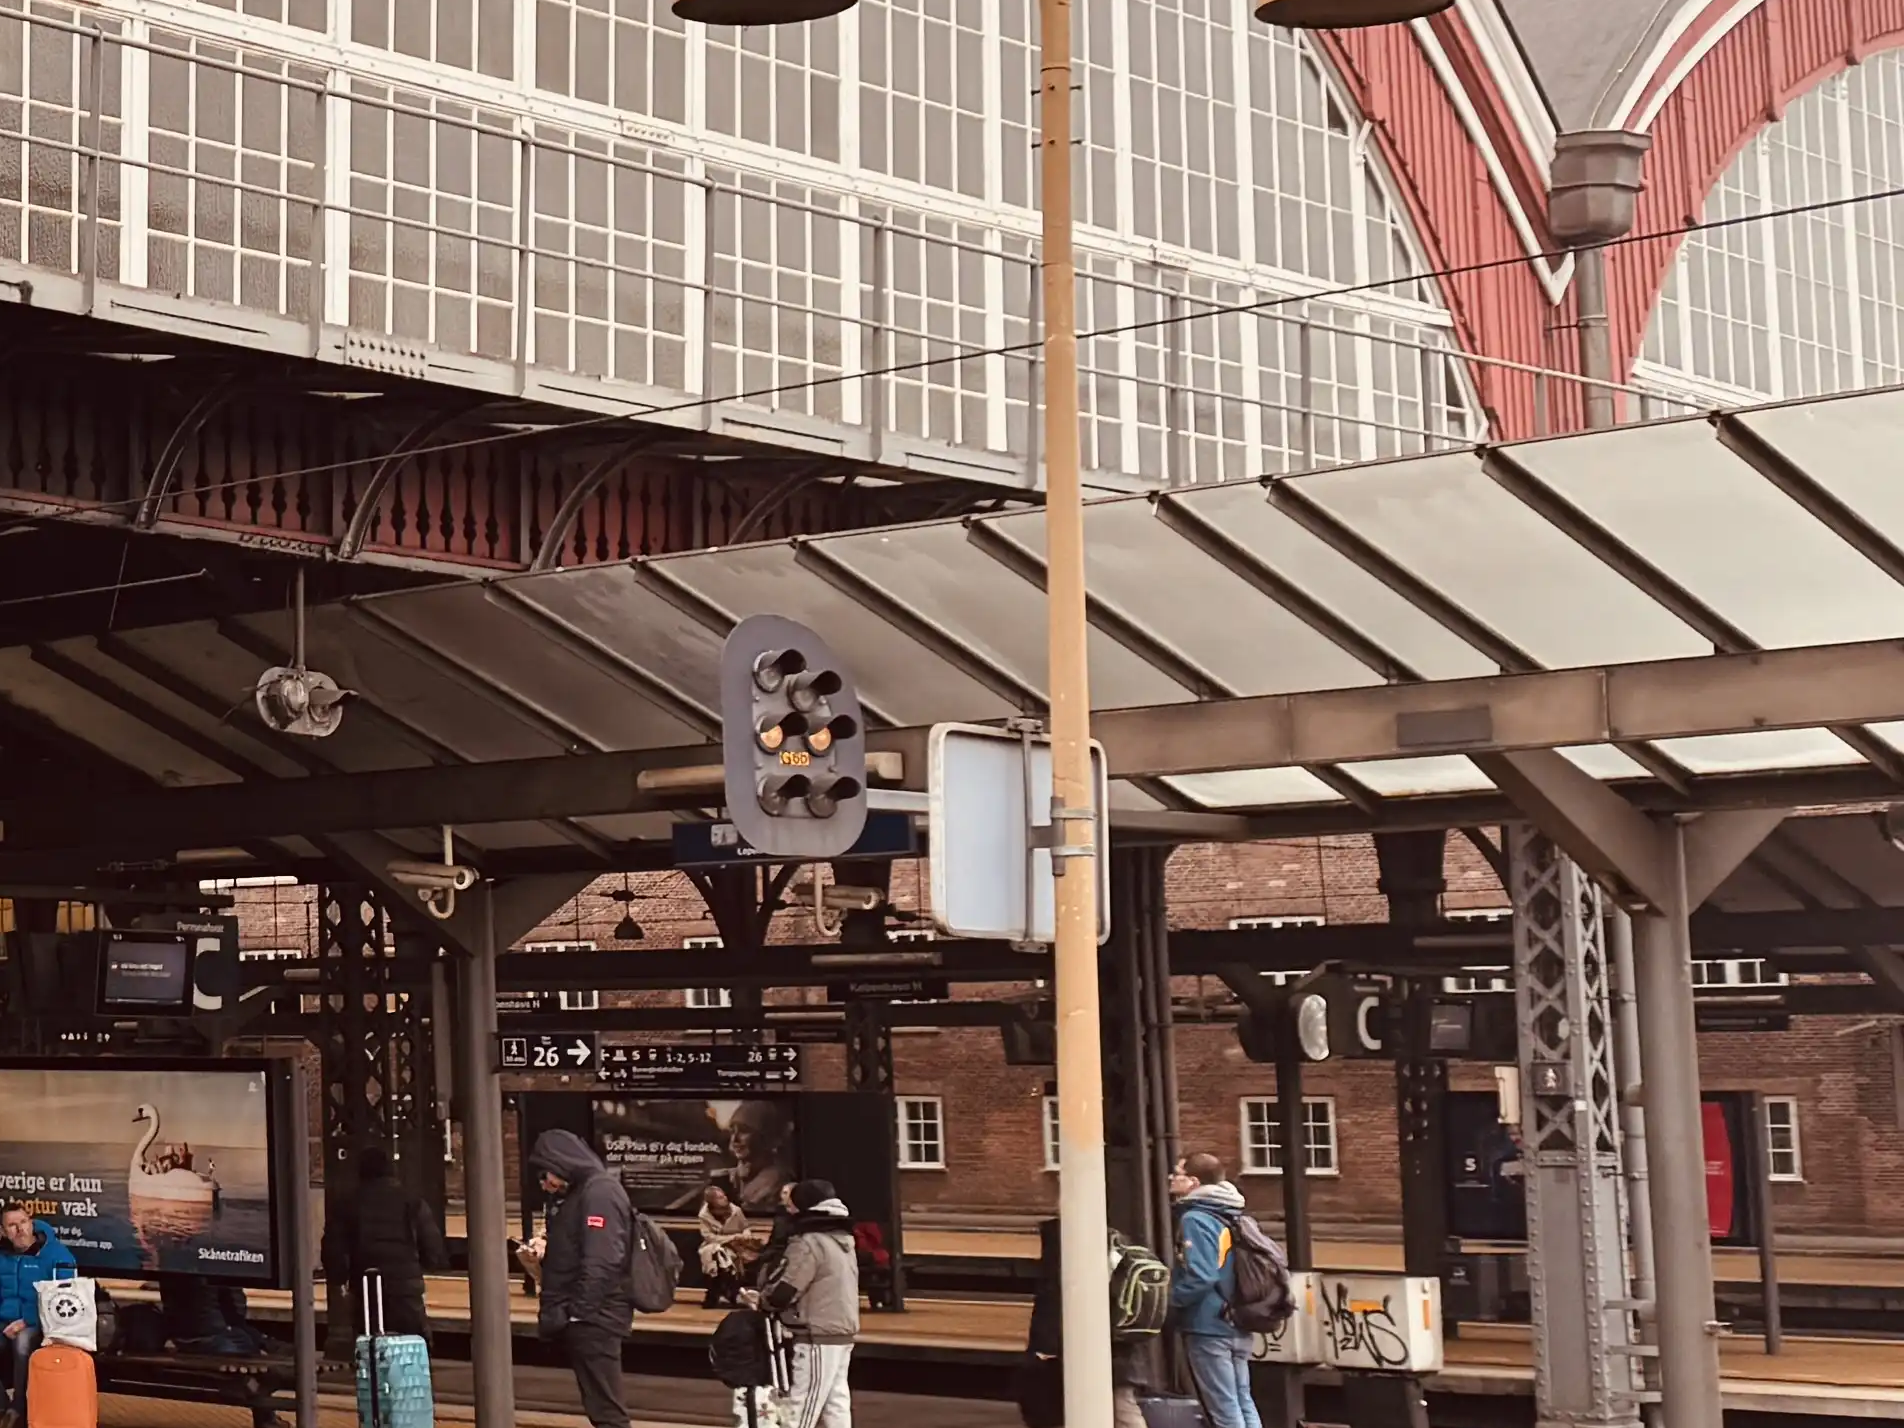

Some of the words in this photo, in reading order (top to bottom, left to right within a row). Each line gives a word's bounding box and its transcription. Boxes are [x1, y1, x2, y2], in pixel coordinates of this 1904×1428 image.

[1357, 996, 1382, 1050] C
[533, 1046, 560, 1067] 26
[631, 1050, 641, 1061] S
[747, 1051, 763, 1063] 26
[49, 1177, 64, 1192] er
[69, 1173, 103, 1193] kun
[62, 1197, 98, 1217] væk
[198, 1247, 264, 1263] Skånetrafiken
